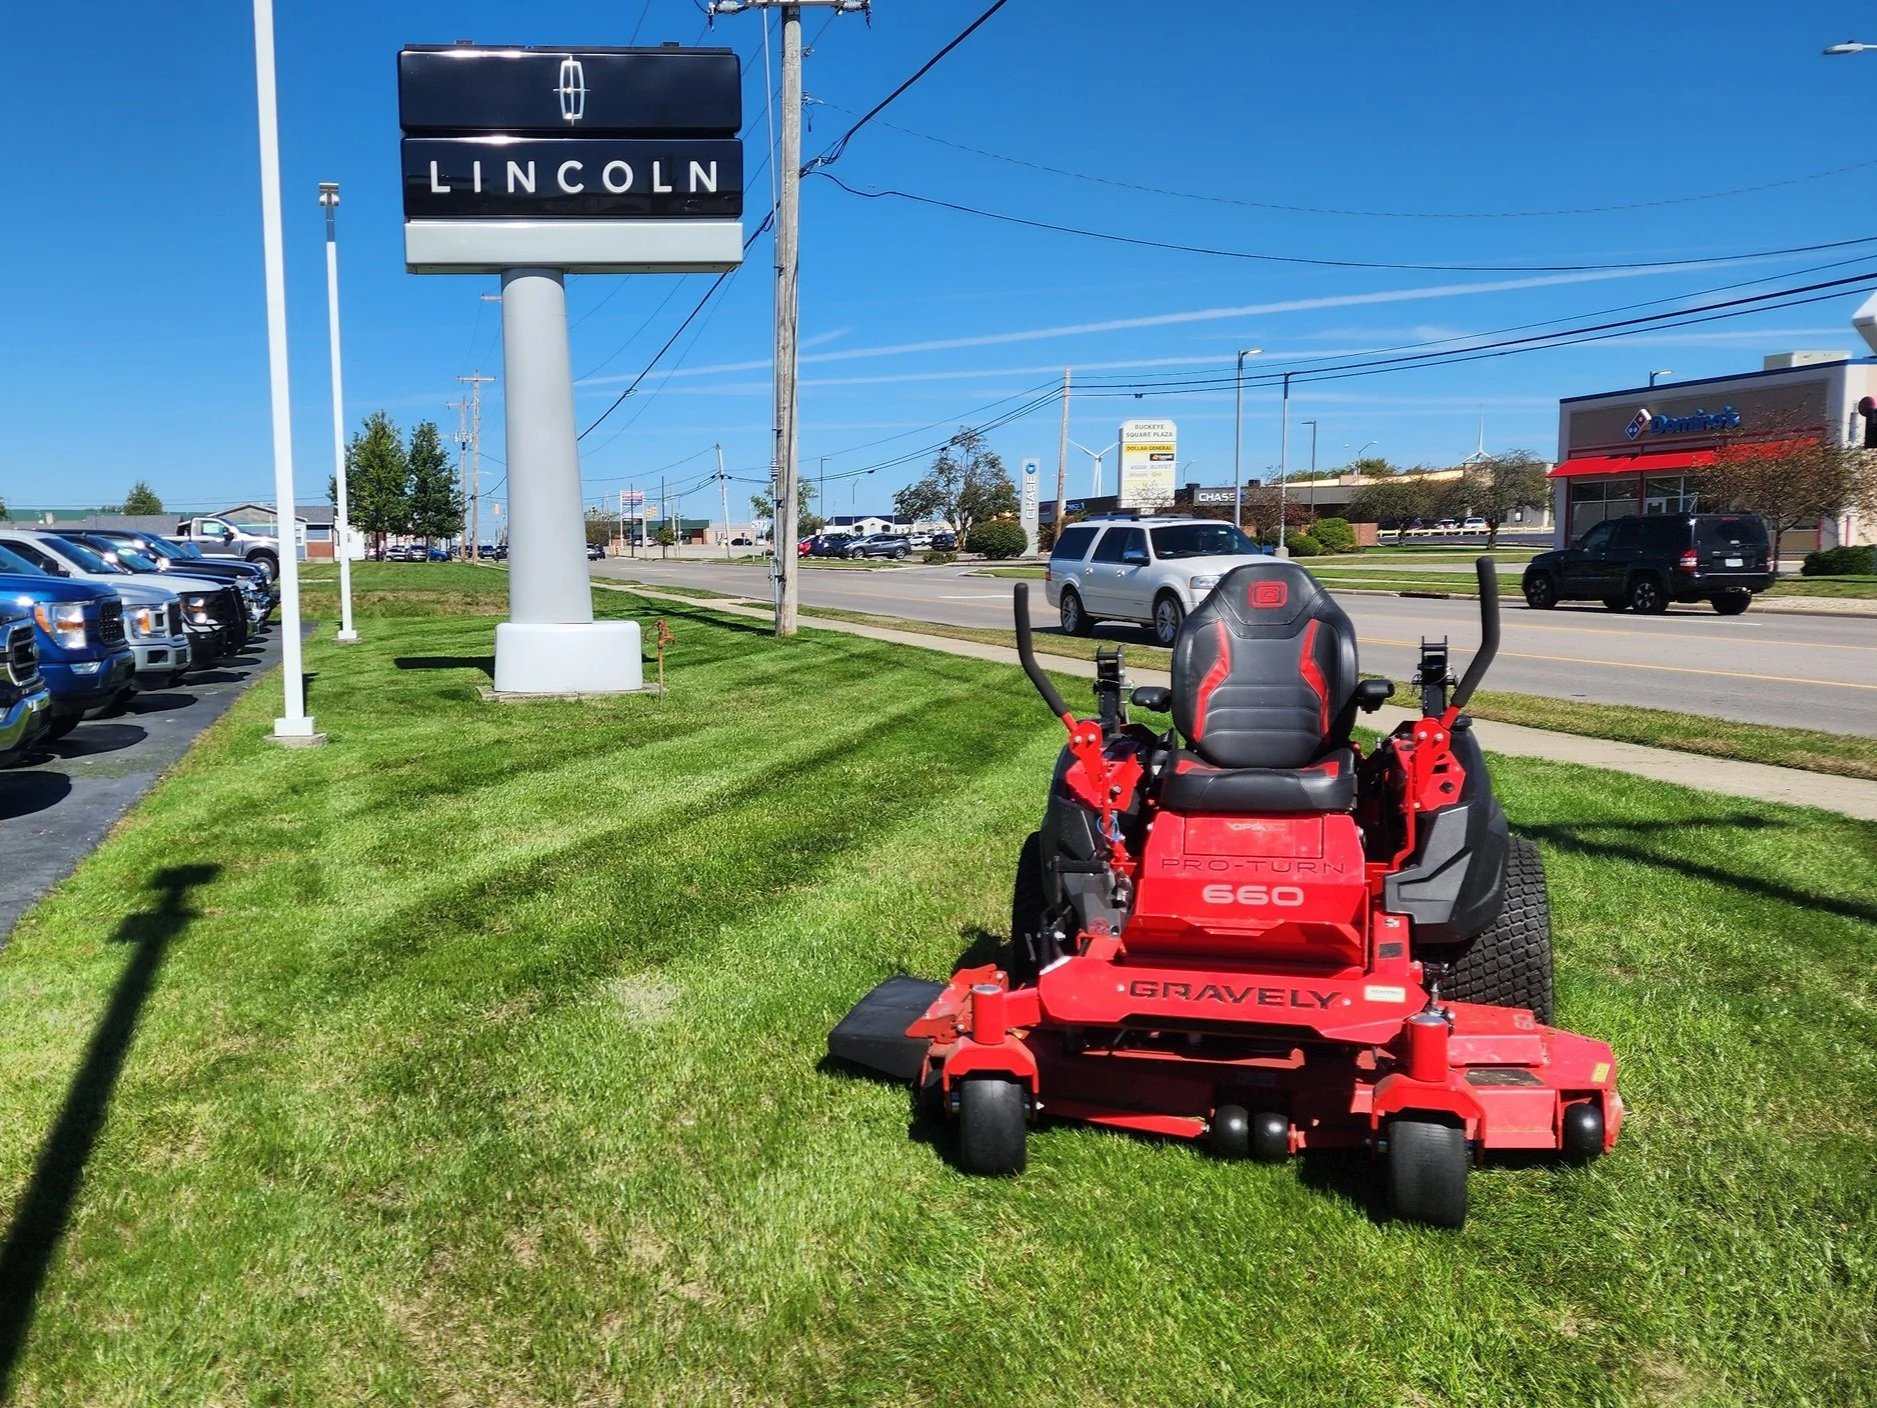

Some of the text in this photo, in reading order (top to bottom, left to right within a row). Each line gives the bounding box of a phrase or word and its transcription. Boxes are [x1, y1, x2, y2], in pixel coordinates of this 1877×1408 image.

[429, 160, 718, 193] LINCOLN
[1649, 405, 1741, 435] Domino's
[1025, 475, 1036, 519] CHASE
[1198, 492, 1236, 502] CHASE
[1161, 858, 1345, 875] PRO-TURN
[1202, 884, 1305, 907] 660
[1129, 980, 1342, 1010] GRAVELY
